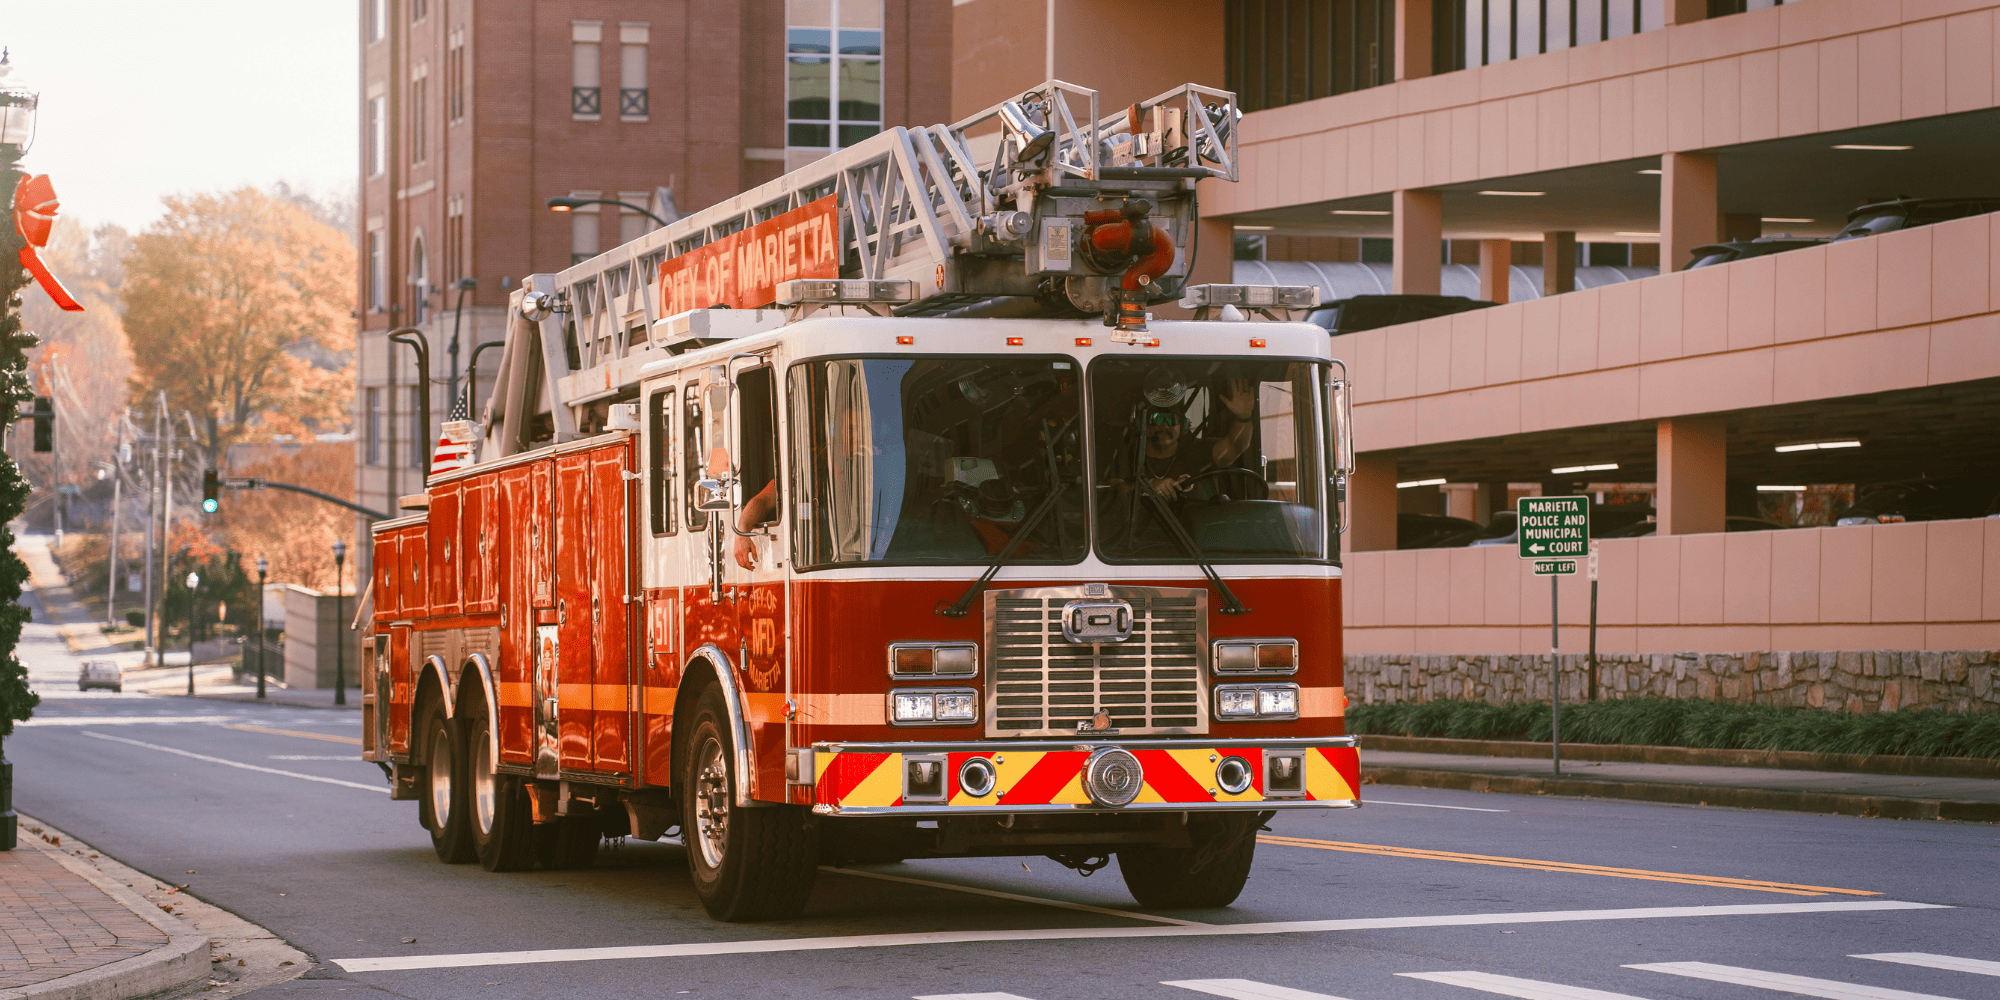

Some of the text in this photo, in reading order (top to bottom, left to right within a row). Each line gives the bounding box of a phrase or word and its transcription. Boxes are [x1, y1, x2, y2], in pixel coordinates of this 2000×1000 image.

[661, 212, 835, 317] CITY OF MARIETTA
[1528, 501, 1579, 513] MARIETTA
[1521, 514, 1585, 527] POLICE AND
[1525, 528, 1582, 539] MUNICIPAL
[1549, 541, 1583, 553] COURT
[1535, 562, 1575, 572] NEXT LEFT
[655, 606, 668, 646] 51
[752, 617, 776, 655] MFD
